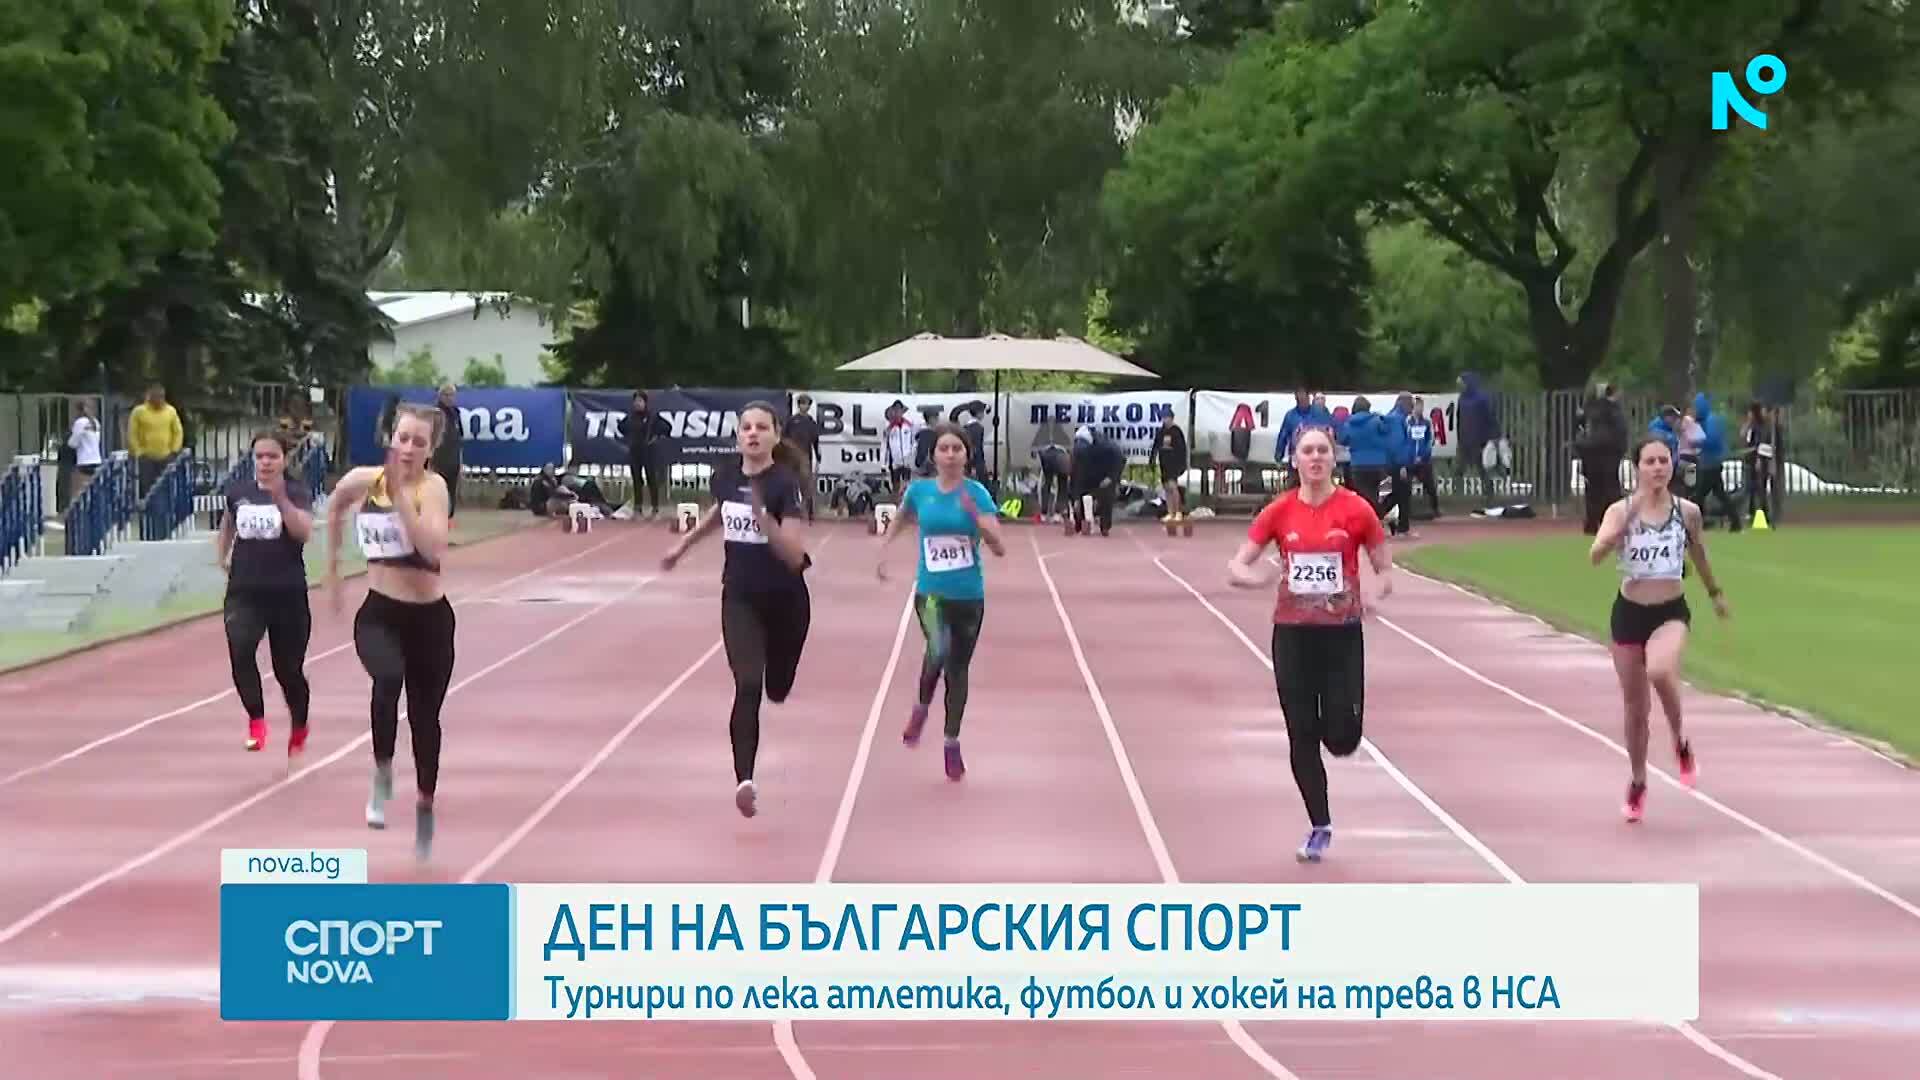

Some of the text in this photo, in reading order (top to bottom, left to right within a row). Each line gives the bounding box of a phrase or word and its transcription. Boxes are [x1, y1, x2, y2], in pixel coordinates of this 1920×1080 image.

[1030, 401, 1173, 424] ПЕЙКОМ
[1631, 546, 1670, 561] 2074
[1293, 565, 1337, 582] 2256
